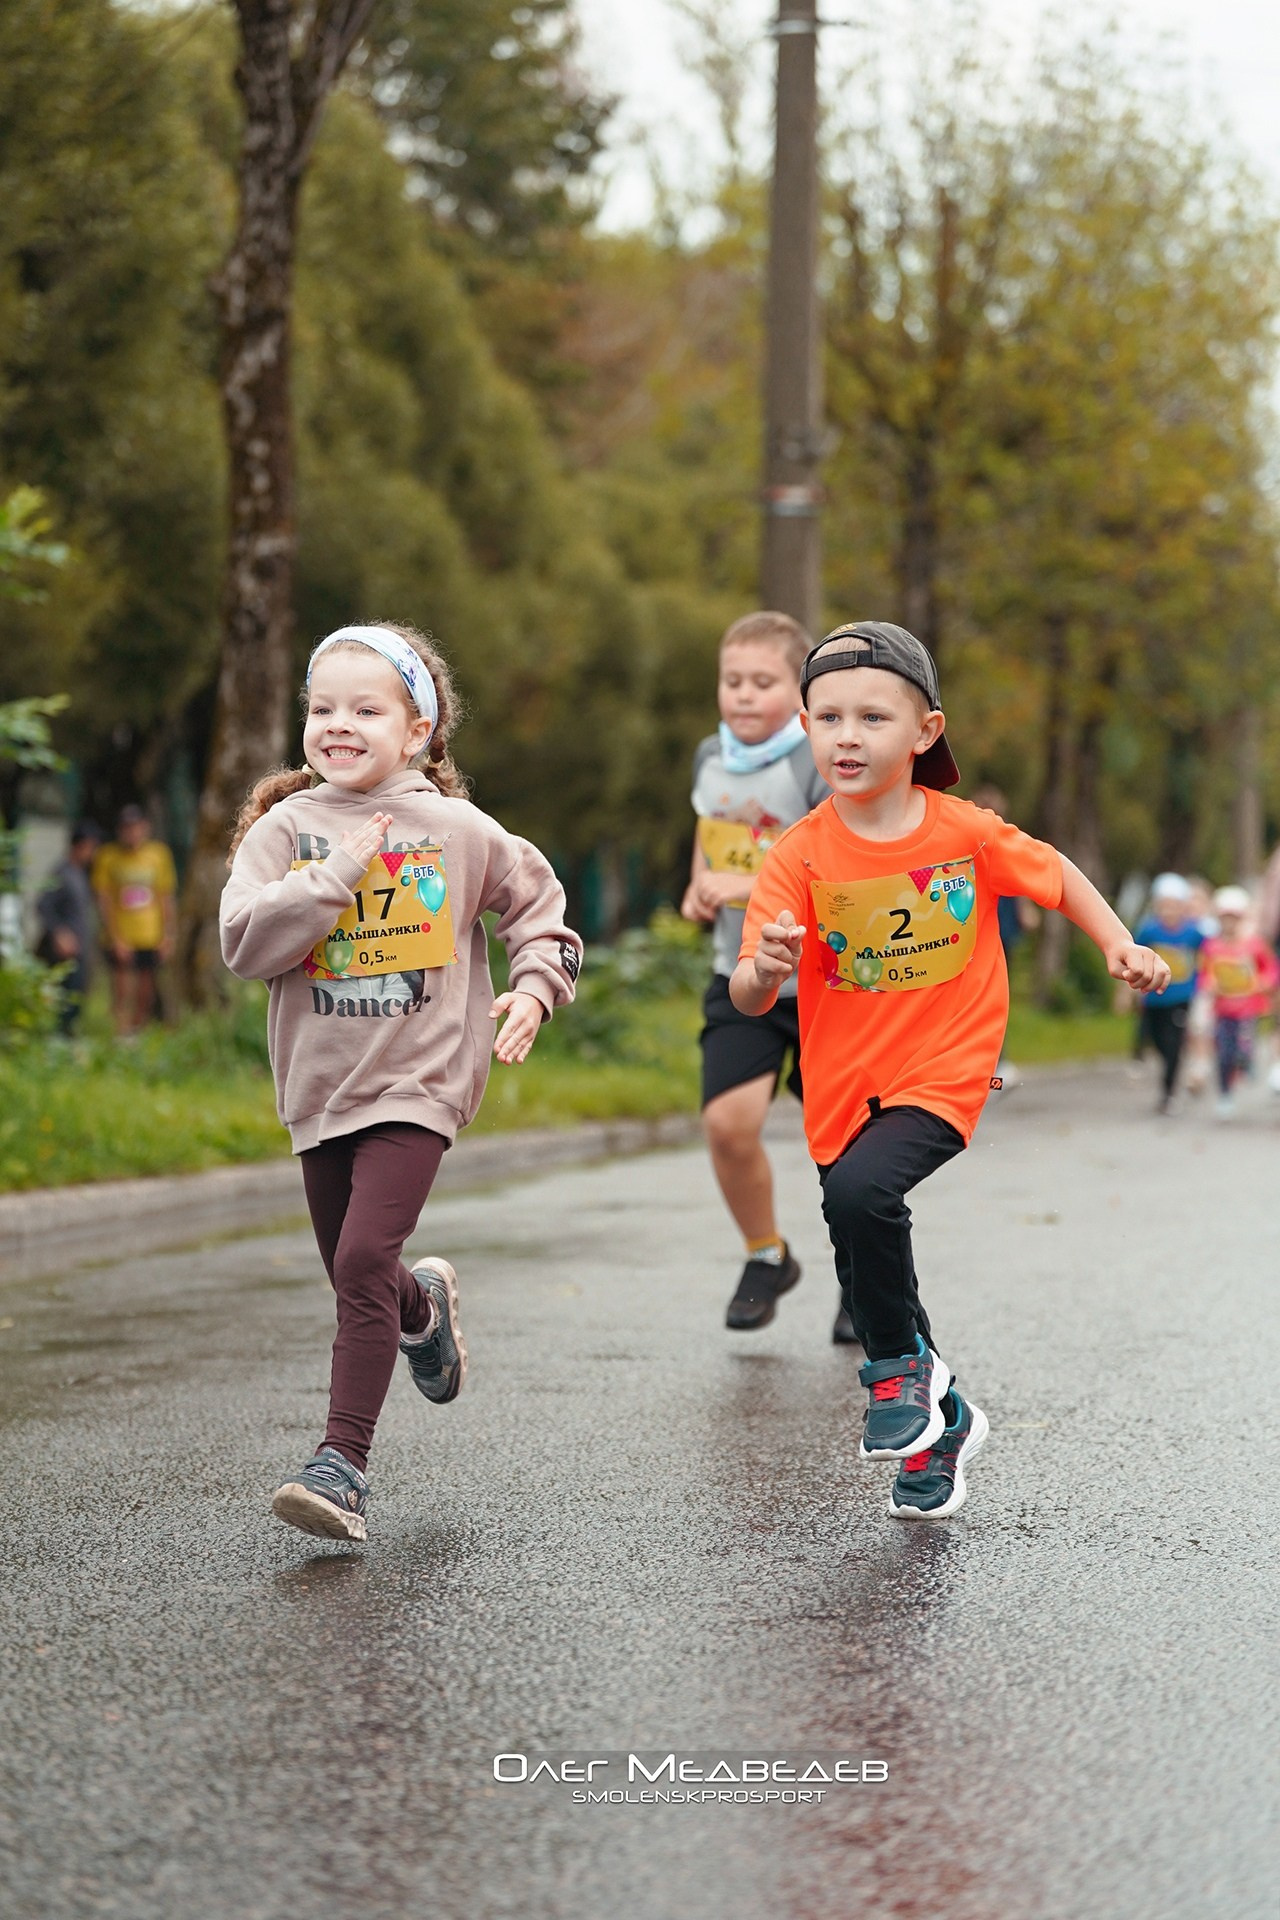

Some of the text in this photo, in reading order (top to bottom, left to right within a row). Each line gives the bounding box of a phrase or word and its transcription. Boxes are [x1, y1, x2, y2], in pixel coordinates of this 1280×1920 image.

[413, 866, 435, 879] ВТБ
[943, 877, 966, 892] ВТБ
[354, 888, 396, 922] 17
[328, 924, 421, 943] МАЛЫШАРИКИ
[889, 908, 913, 941] 2
[856, 937, 950, 959] МАЛЫШАРИКИ
[308, 986, 431, 1018] Dancer
